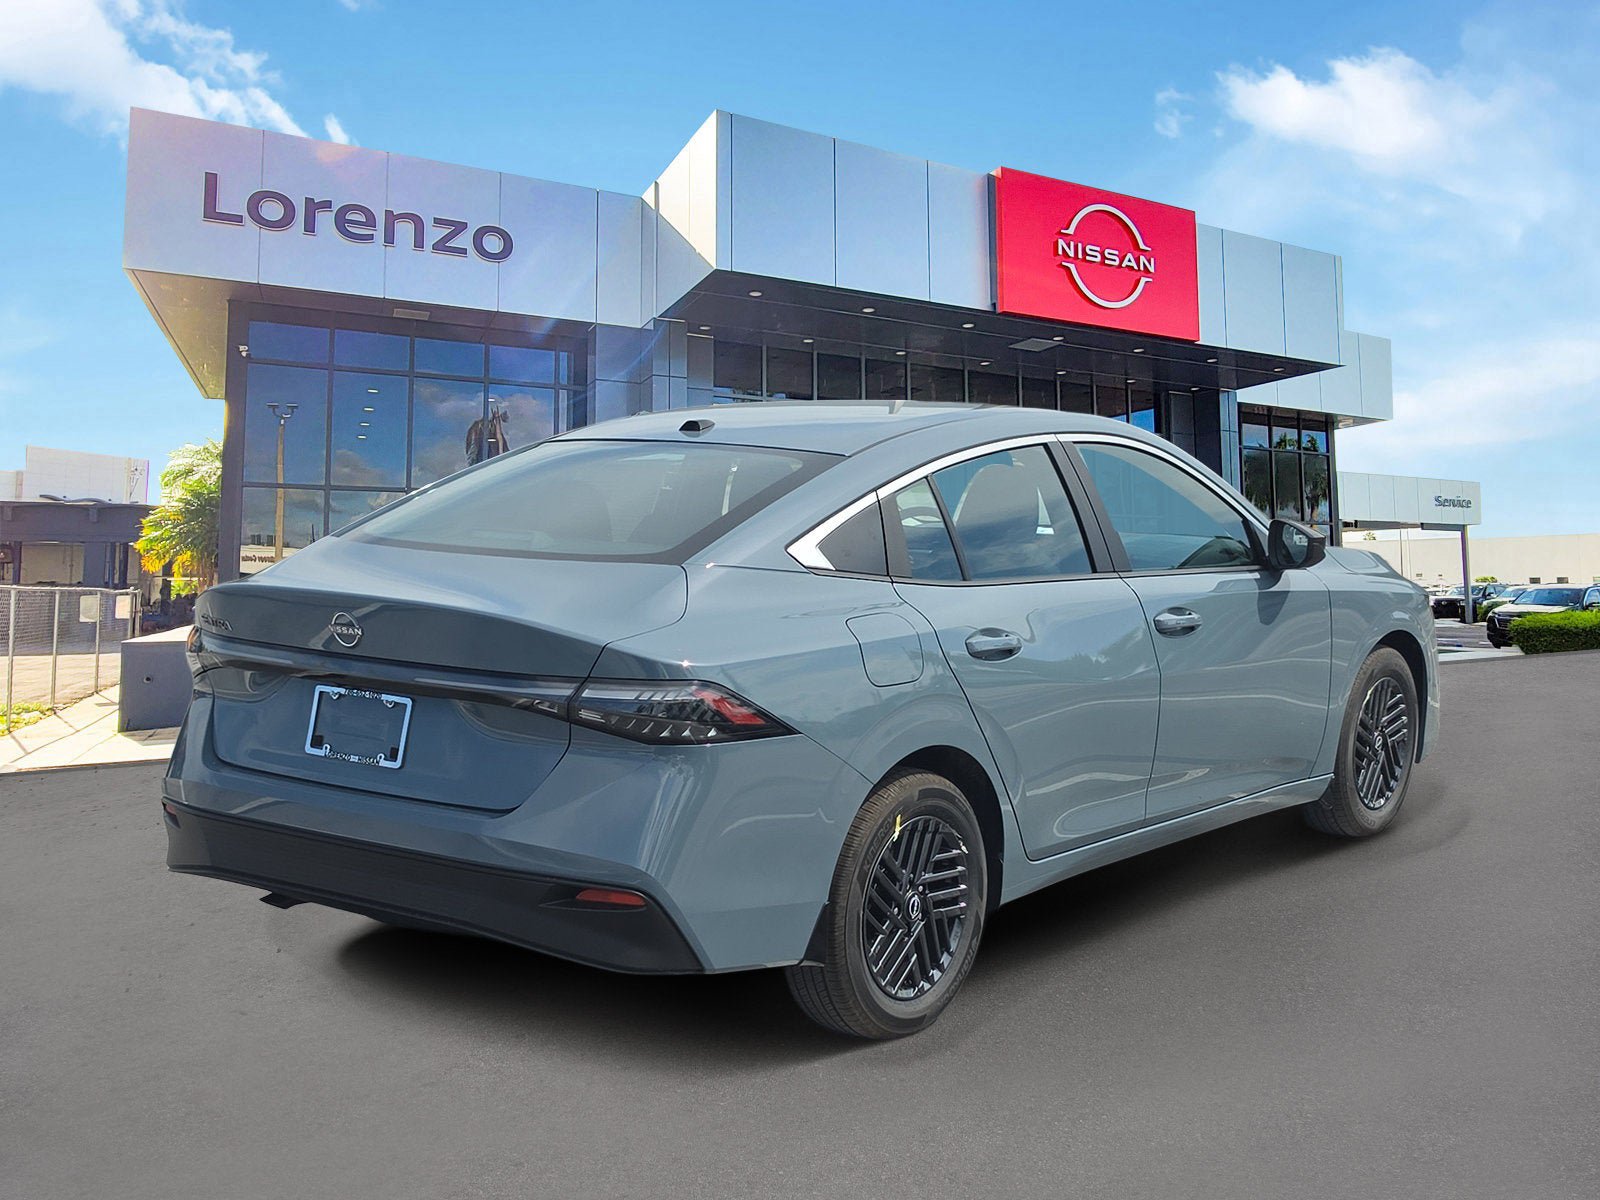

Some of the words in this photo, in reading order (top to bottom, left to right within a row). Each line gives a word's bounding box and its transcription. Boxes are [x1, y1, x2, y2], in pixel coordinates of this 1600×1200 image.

[202, 171, 514, 263] Lorenzo
[1057, 238, 1155, 273] NISSAN
[1434, 495, 1472, 508] Service
